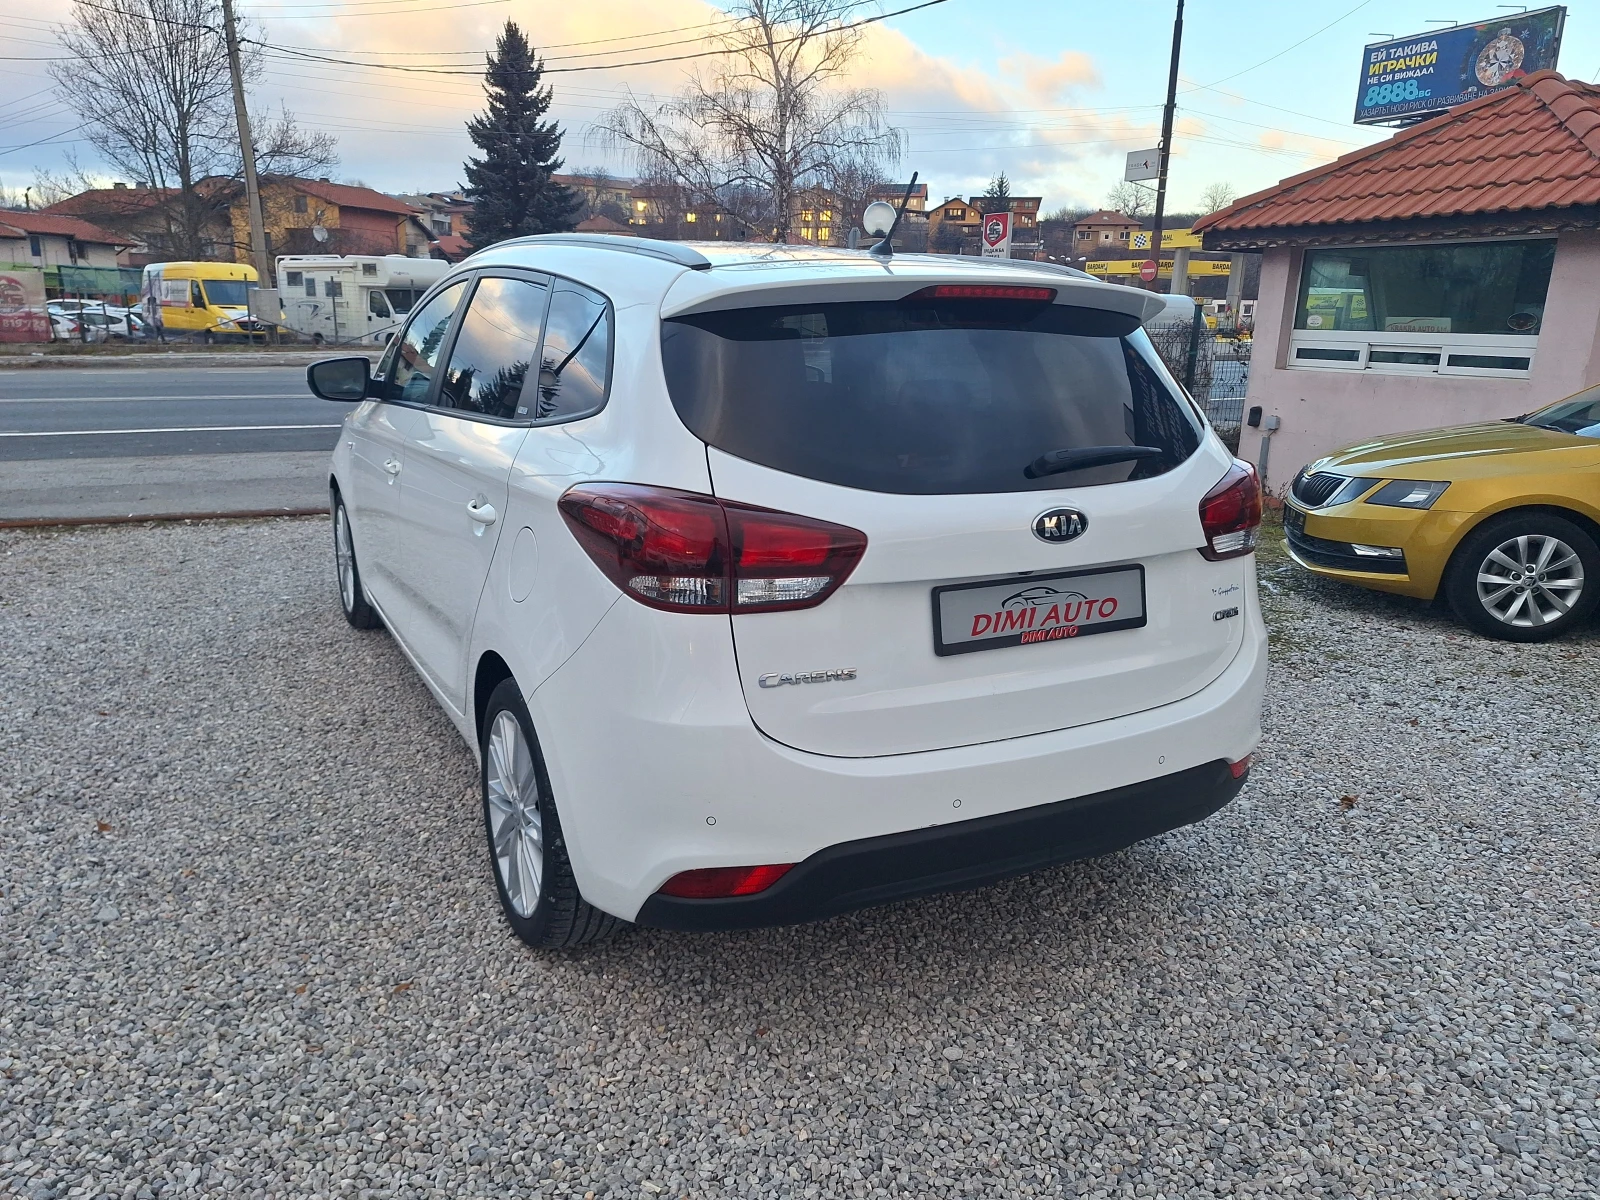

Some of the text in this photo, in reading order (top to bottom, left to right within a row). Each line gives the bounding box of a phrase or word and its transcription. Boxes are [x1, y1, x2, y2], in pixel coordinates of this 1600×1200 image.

[1370, 40, 1438, 63] ЕЙ ТАКИВА
[1367, 66, 1434, 85] НЕ СИ ВИЖДАЛ
[1368, 52, 1438, 76] ИГРАЧКИ
[1363, 79, 1432, 107] 8888.BG
[1042, 514, 1082, 538] KIA
[971, 597, 1118, 637] DIMI AUTO
[1020, 626, 1079, 644] DIMI AUTO
[758, 667, 857, 689] CARENS
